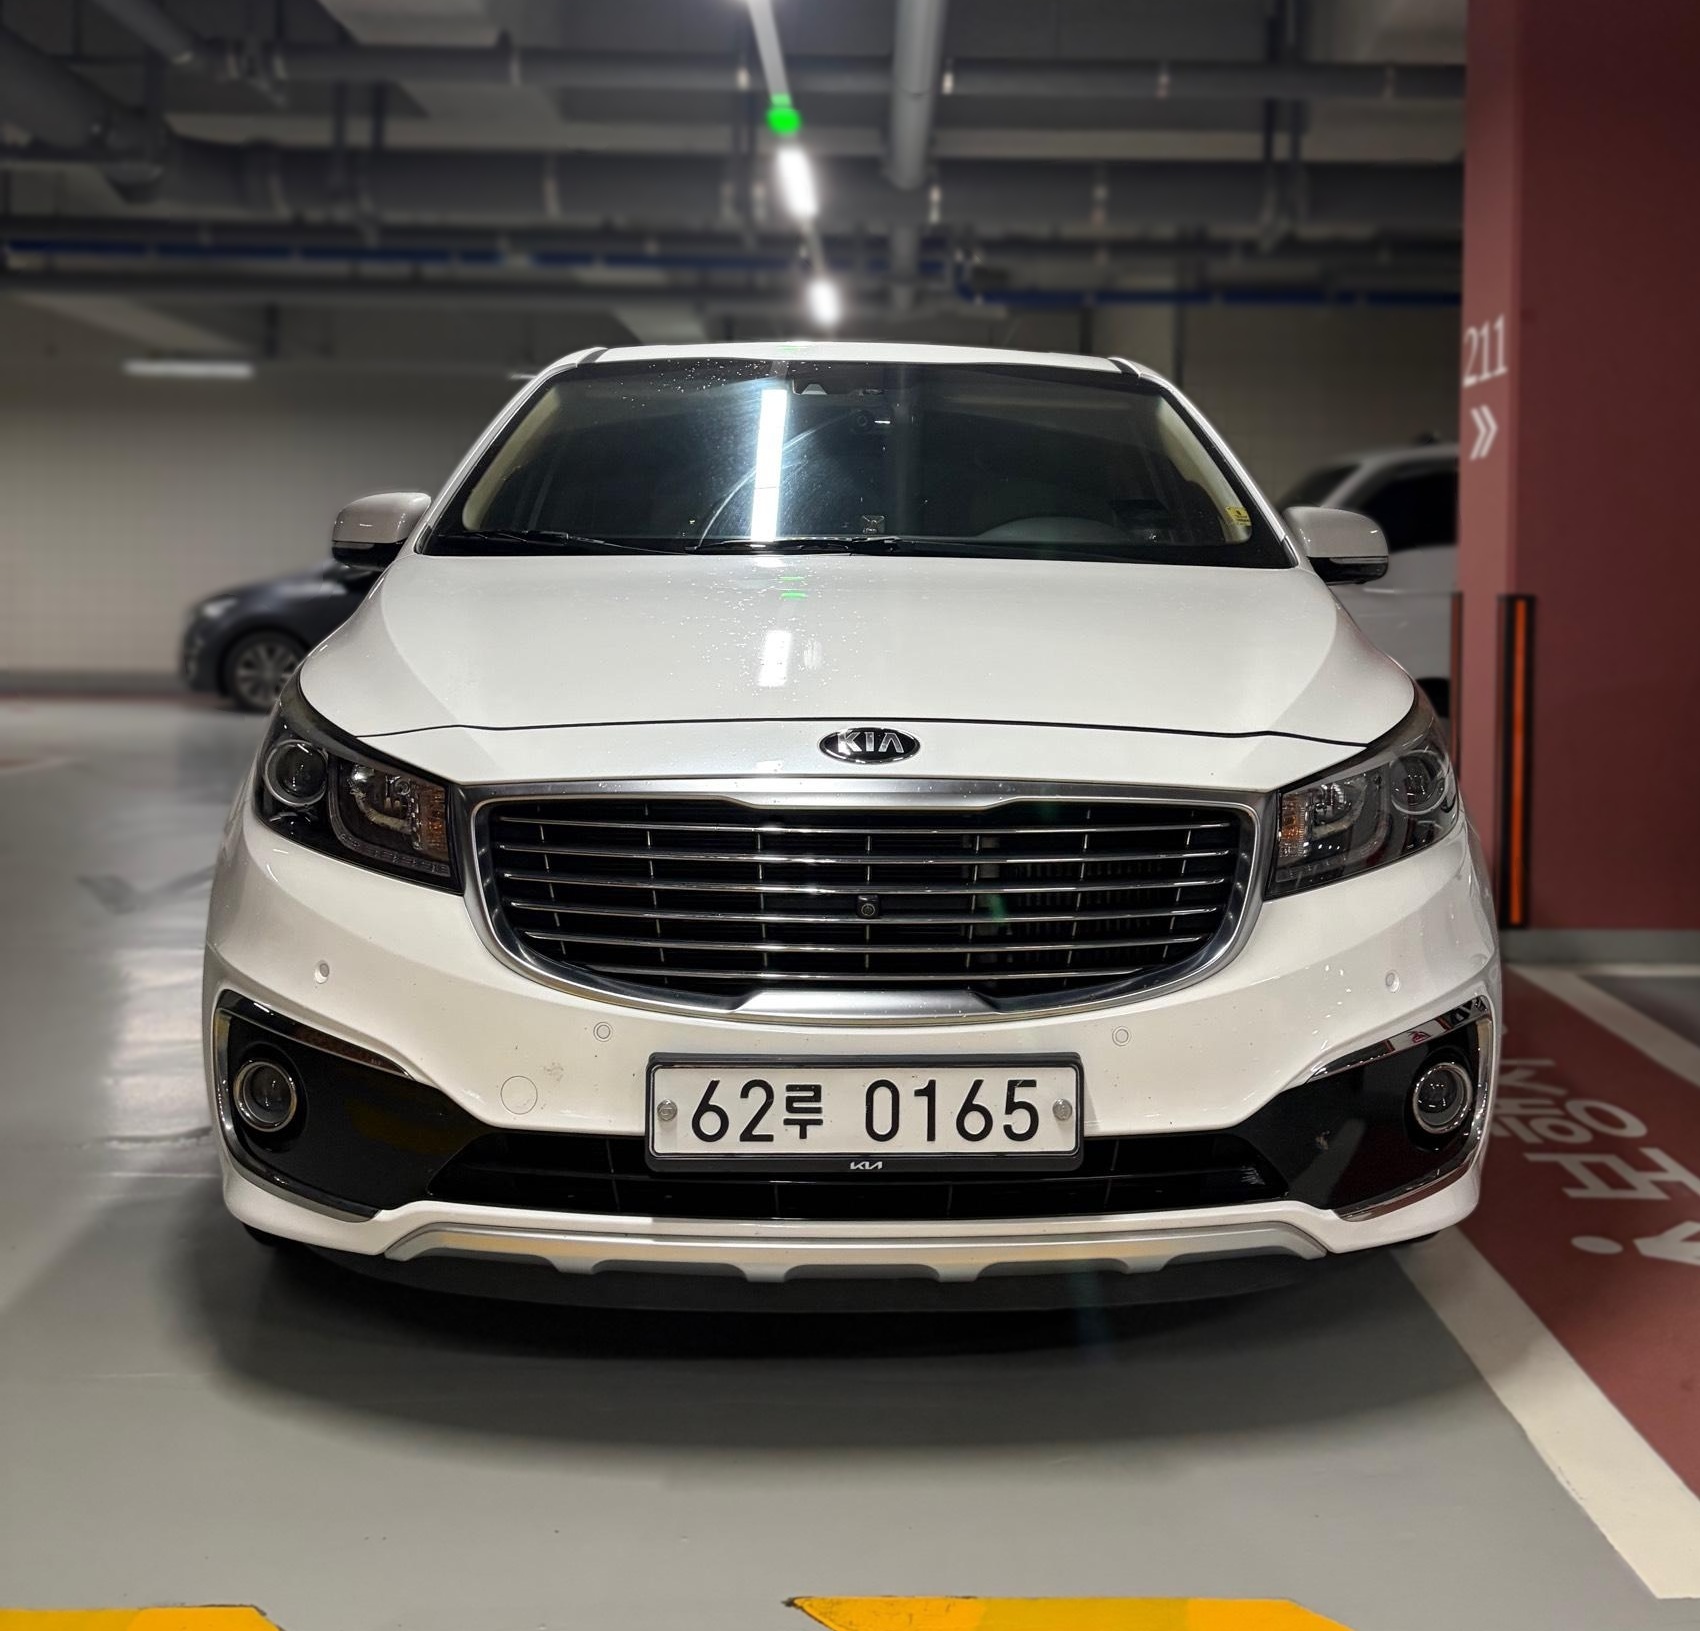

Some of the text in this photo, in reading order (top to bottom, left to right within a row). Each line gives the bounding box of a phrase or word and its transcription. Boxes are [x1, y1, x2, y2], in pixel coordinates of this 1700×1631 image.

[1462, 314, 1508, 388] 211
[837, 730, 904, 754] KIA
[691, 1079, 1040, 1143] 62루 0165
